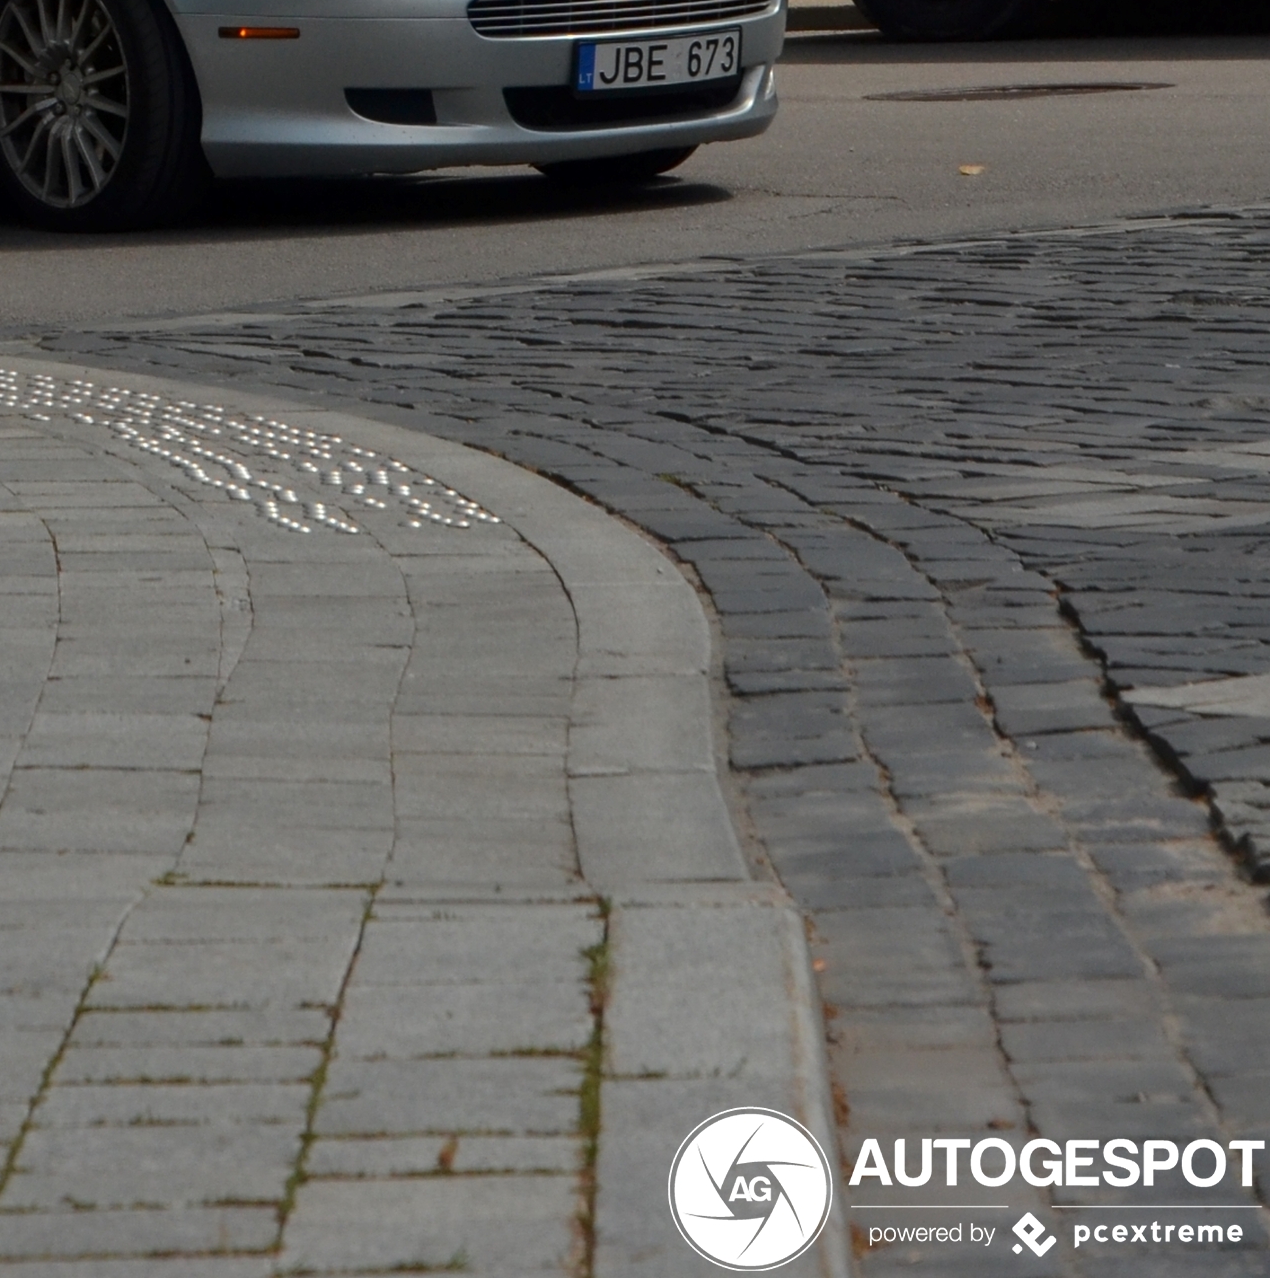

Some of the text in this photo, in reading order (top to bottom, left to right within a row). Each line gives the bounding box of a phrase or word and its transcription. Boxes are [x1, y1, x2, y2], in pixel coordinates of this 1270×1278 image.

[599, 36, 735, 84] JBE 673
[579, 73, 593, 84] LT
